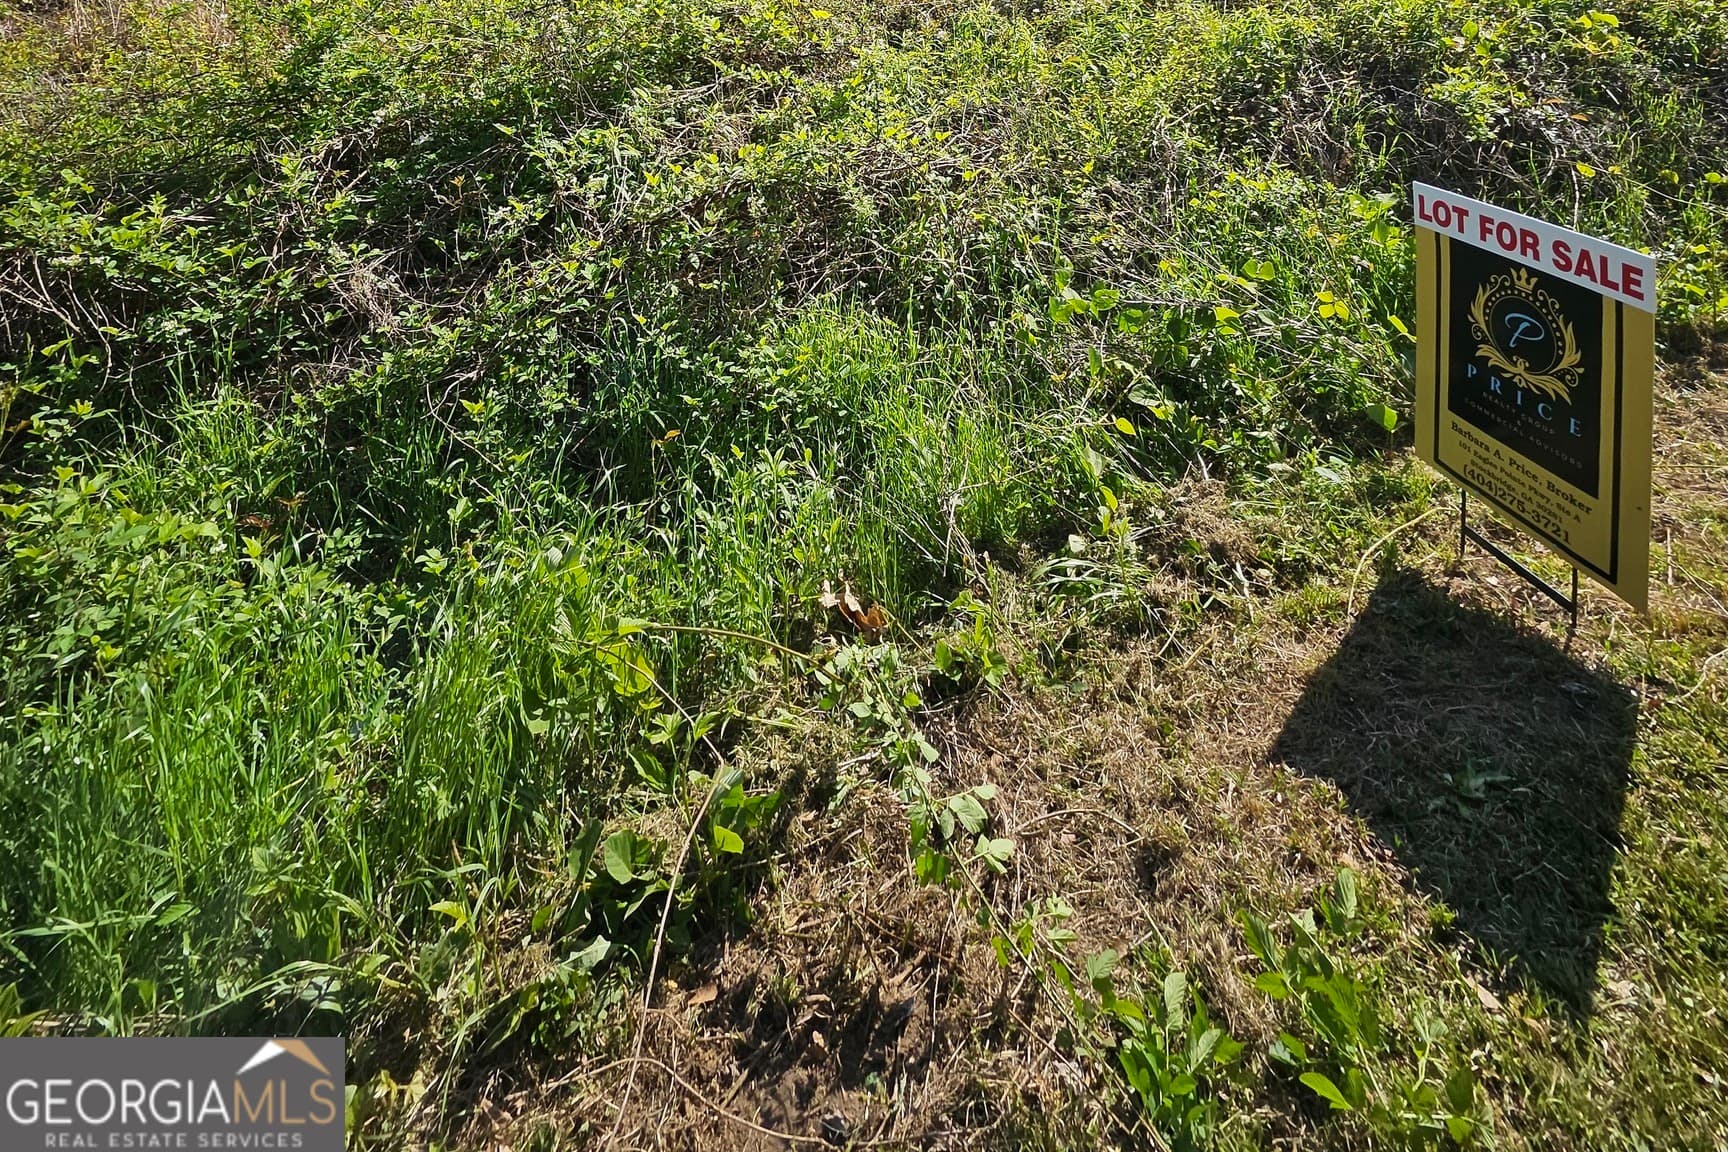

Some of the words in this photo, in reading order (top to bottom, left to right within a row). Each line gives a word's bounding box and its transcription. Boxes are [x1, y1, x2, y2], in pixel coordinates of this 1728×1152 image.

[1418, 194, 1469, 234] LOT
[1479, 214, 1540, 262] FOR
[1551, 239, 1645, 301] SALE
[1466, 363, 1582, 438] PRICE
[1451, 421, 1490, 453] Barbara
[1493, 449, 1505, 462] A.
[1547, 480, 1593, 514] Broker
[1463, 464, 1571, 545] (404)275-3721
